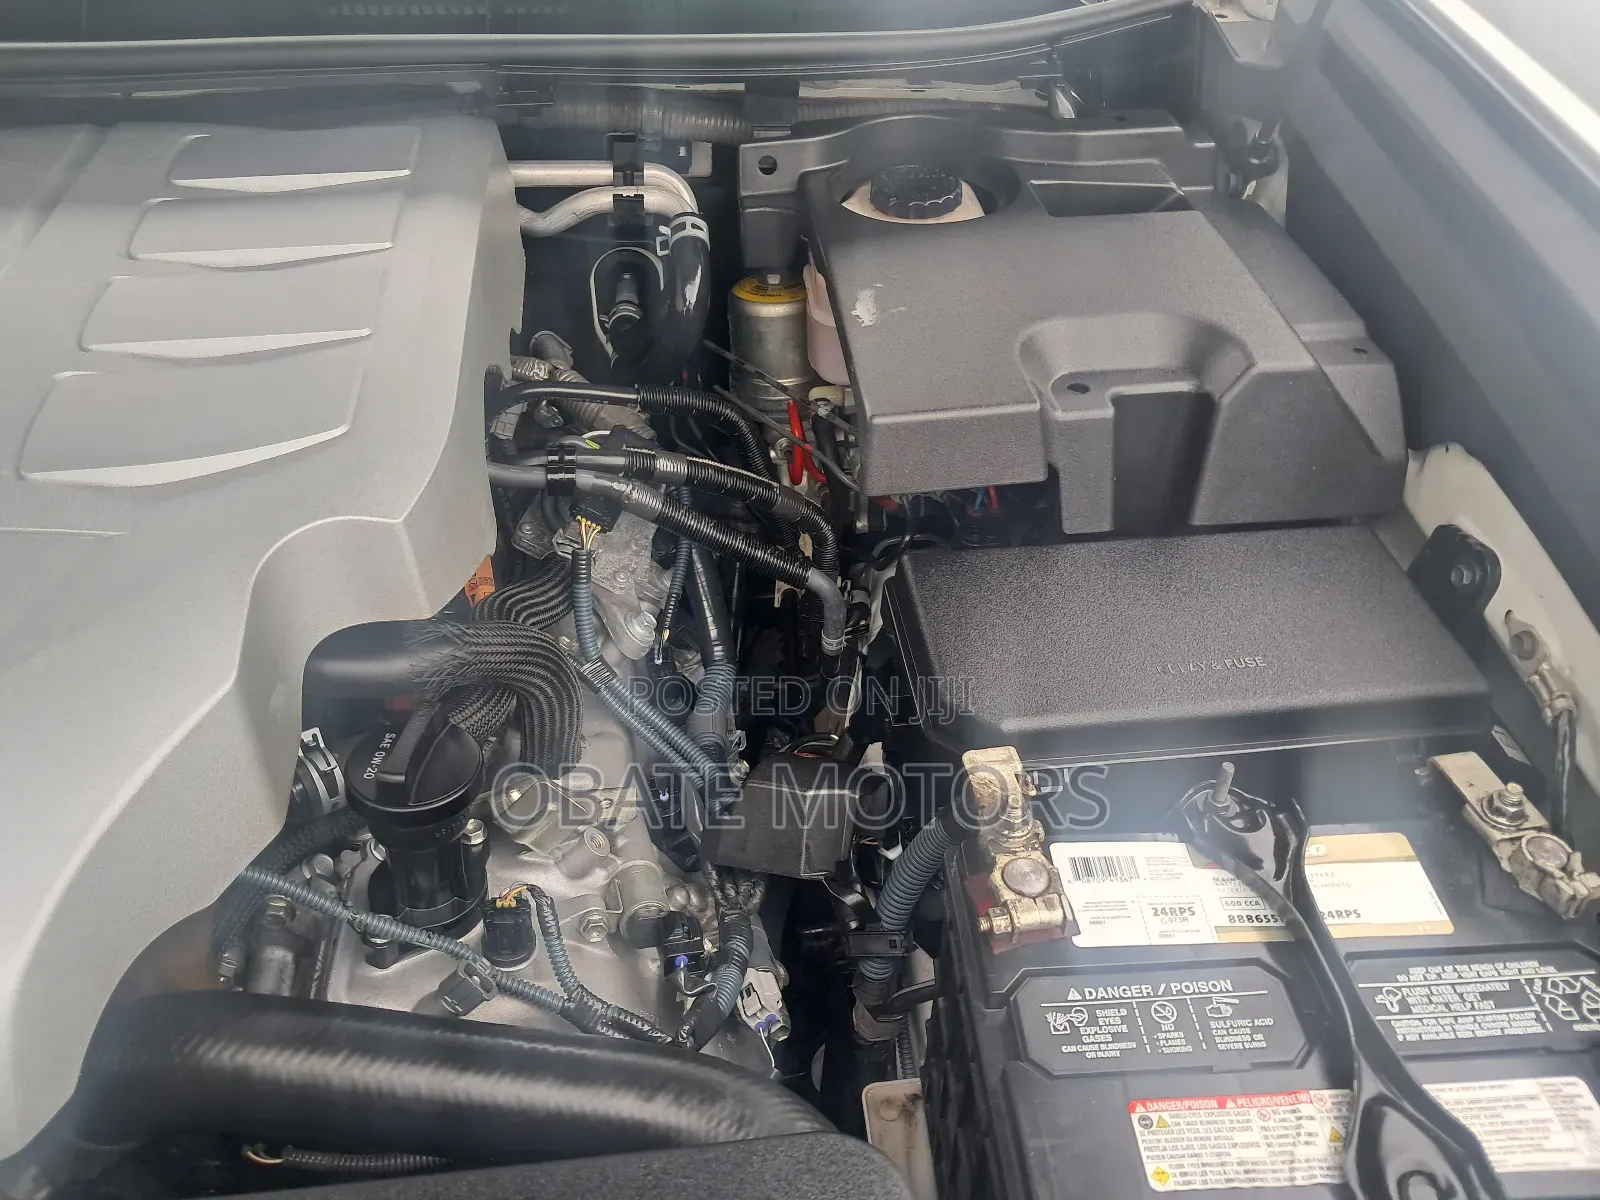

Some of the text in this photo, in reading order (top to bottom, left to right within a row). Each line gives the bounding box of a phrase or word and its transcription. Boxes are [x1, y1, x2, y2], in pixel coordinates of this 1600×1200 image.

[1224, 656, 1267, 669] FUSE
[379, 732, 396, 749] SAE
[1152, 906, 1196, 916] 24RPS
[1084, 980, 1234, 1000] DANGER / POISON
[1401, 982, 1510, 997] FLUSH EYES IMMEDIATELY
[1405, 996, 1430, 1005] WITH
[1463, 992, 1481, 1002] GET
[1410, 1000, 1496, 1014] MEDICAL HELP FAST
[1096, 1008, 1127, 1017] SHIELD
[1098, 1017, 1122, 1025] EYES
[1209, 1018, 1274, 1028] SULFURIC ACID
[1080, 1025, 1129, 1035] EXPLOSIVE
[1161, 1024, 1174, 1032] NO
[1082, 1034, 1112, 1043] GASES
[1214, 1035, 1251, 1043] BLINDNESS
[1100, 1042, 1136, 1050] BLINDNESS
[1162, 1046, 1194, 1054] SMOKING
[1146, 1099, 1218, 1112] DANGER/POISON
[1236, 1092, 1312, 1108] PELIGRO/VENENO
